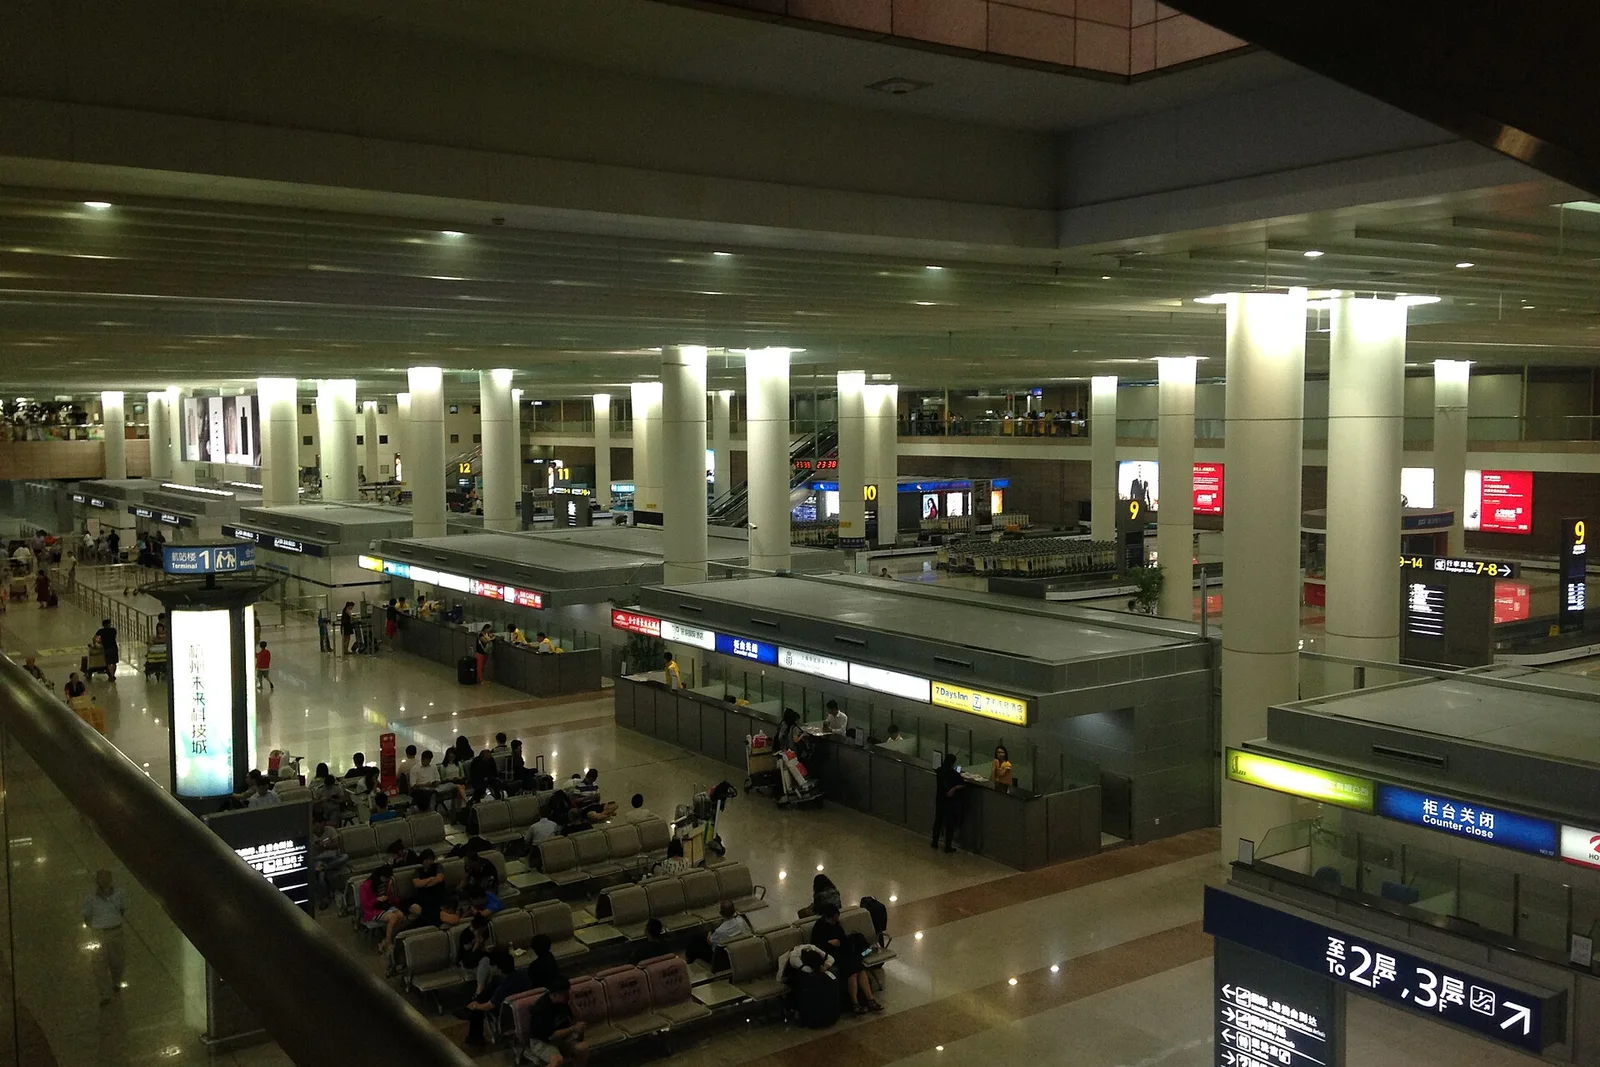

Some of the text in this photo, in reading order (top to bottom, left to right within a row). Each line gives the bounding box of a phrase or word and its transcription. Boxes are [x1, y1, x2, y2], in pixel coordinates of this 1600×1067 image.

[459, 463, 471, 474] 12
[557, 468, 570, 480] 11
[1129, 500, 1140, 520] 9
[1574, 520, 1586, 545] 9
[198, 550, 210, 570] 1
[1475, 562, 1498, 576] 7-8
[188, 644, 208, 755] 杭州未来科技城
[1422, 798, 1495, 829] 柜台关闭
[1422, 814, 1494, 839] Counter close
[1326, 957, 1346, 976] To
